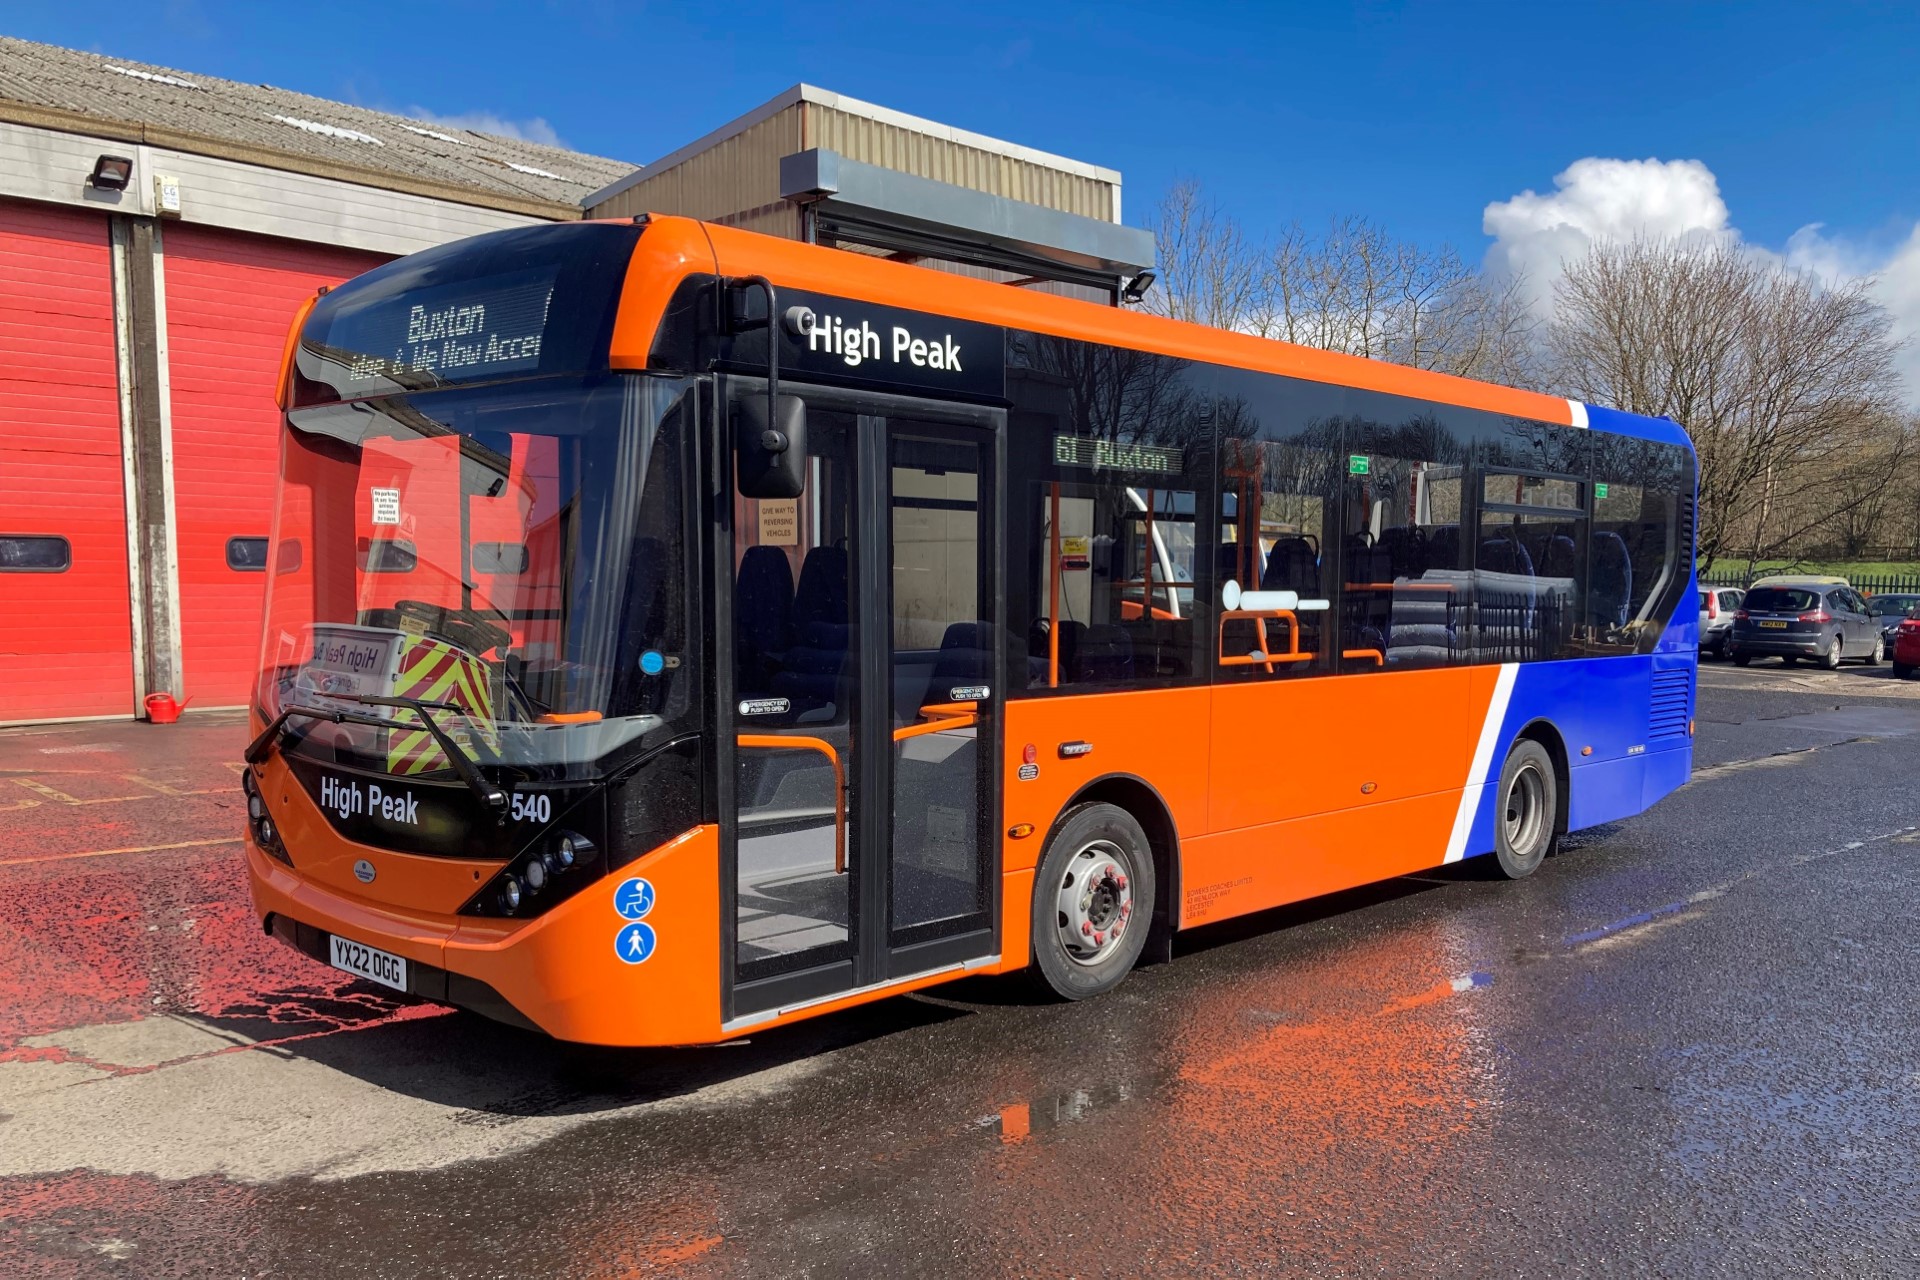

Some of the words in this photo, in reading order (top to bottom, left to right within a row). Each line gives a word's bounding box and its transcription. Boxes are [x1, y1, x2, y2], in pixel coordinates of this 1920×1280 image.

[407, 304, 486, 344] Buxton
[412, 344, 438, 372] We
[440, 340, 482, 368] Now
[810, 313, 881, 366] High
[893, 326, 963, 372] Peak
[1057, 436, 1078, 463] 61
[1096, 440, 1168, 471] Buxton
[761, 507, 774, 515] GIVE
[787, 506, 795, 514] TO
[763, 518, 793, 526] REVERSING
[766, 529, 792, 537] VEHICLES
[321, 776, 362, 819] High
[368, 784, 419, 825] Peak
[511, 793, 551, 823] 540
[1209, 880, 1234, 892] COACHES
[1234, 876, 1253, 887] LIMITED
[1219, 889, 1231, 897] WAY
[1186, 899, 1214, 913] LEICESTER
[335, 939, 370, 973] YX22
[373, 952, 400, 984] OGG
